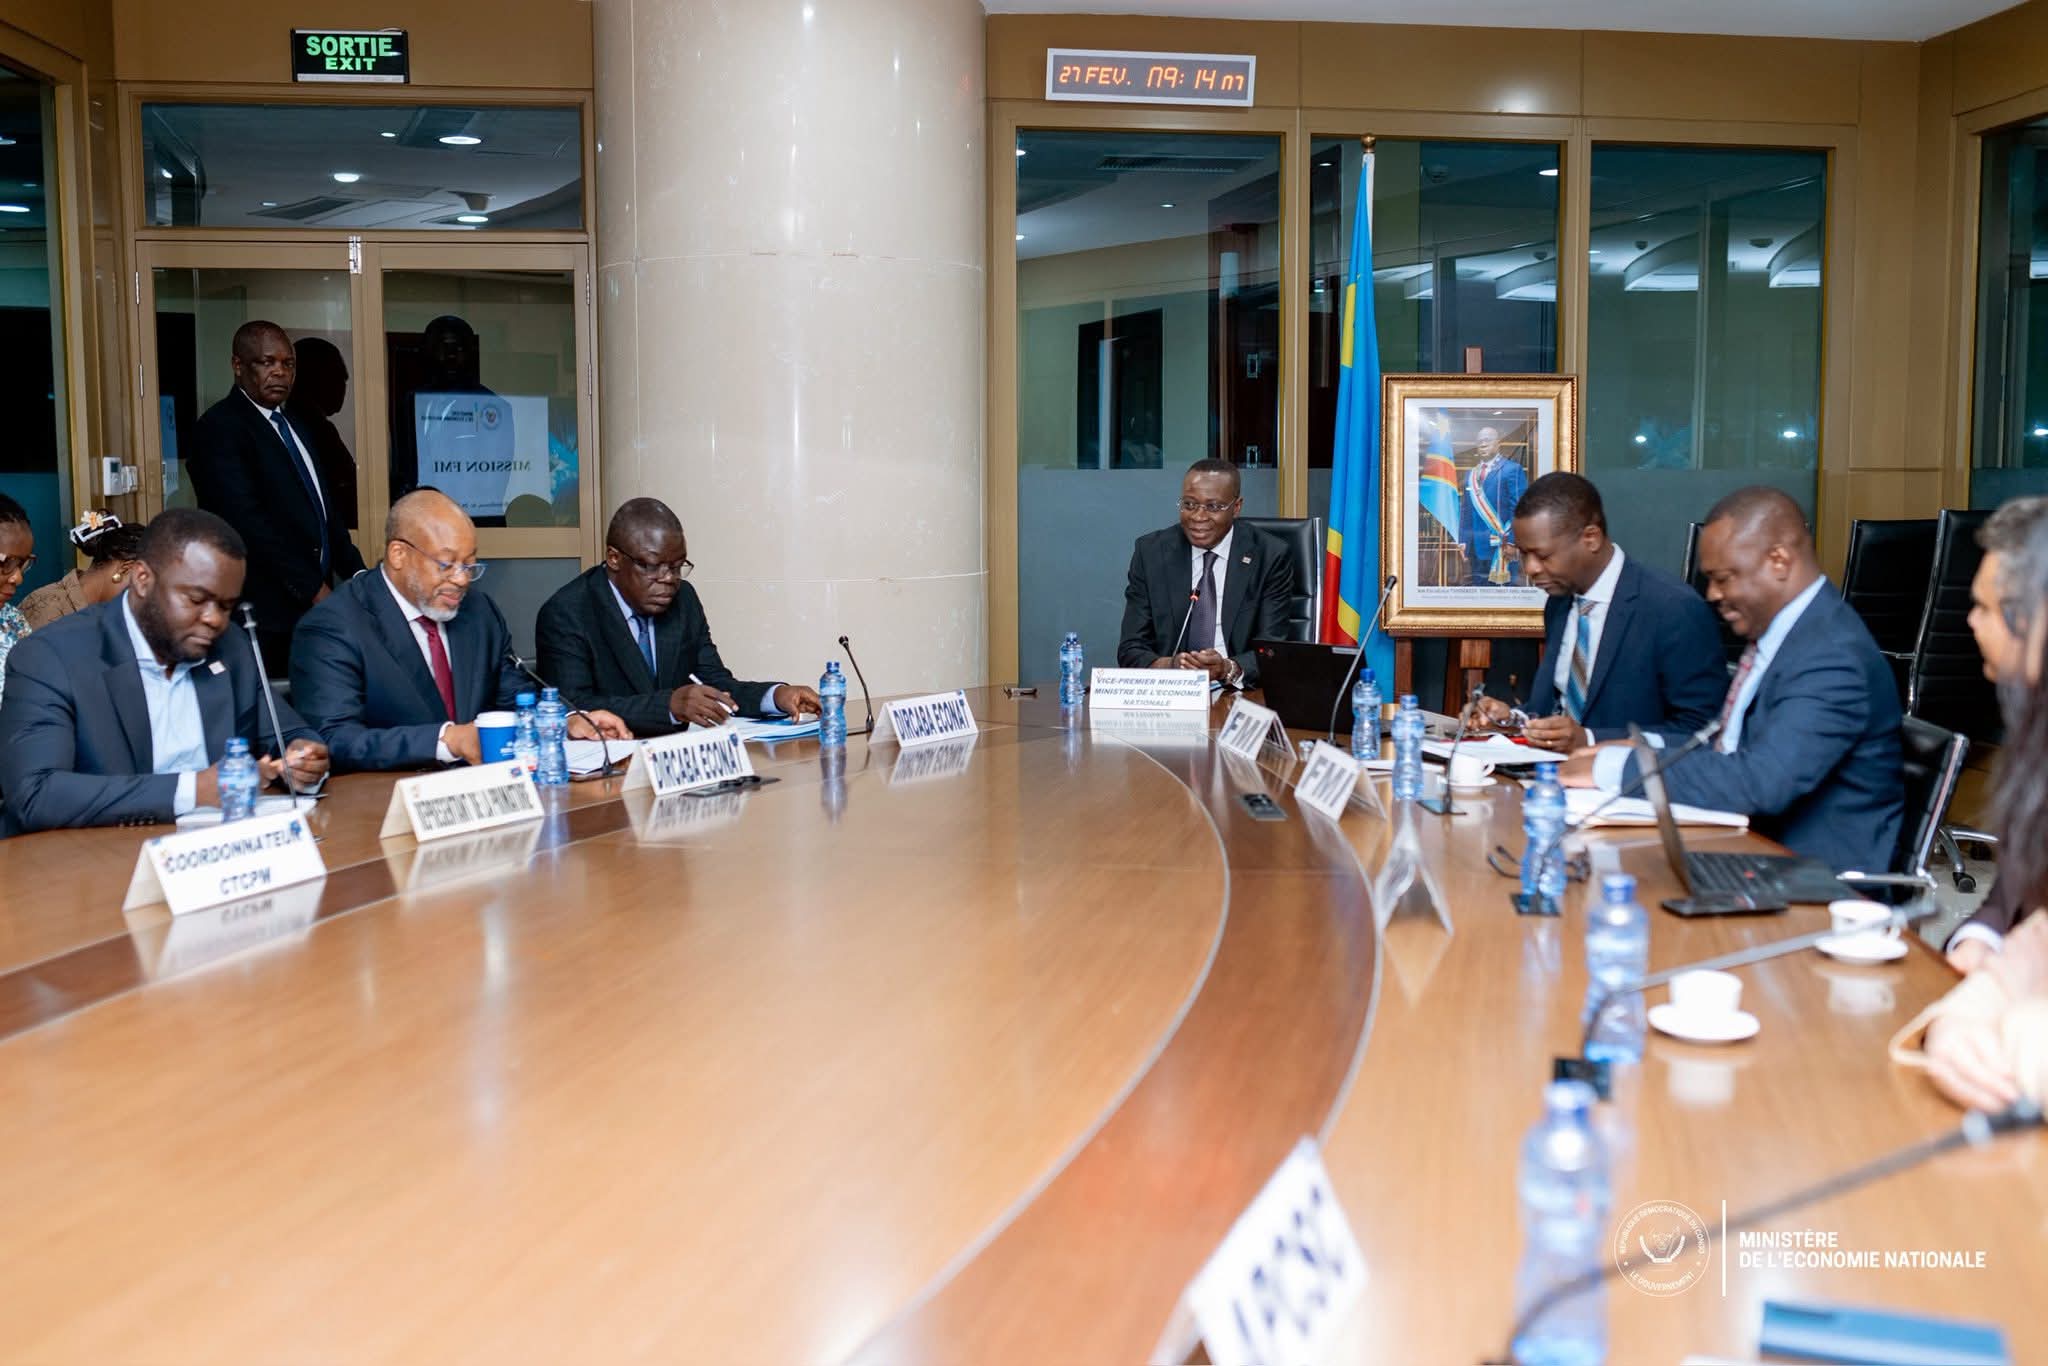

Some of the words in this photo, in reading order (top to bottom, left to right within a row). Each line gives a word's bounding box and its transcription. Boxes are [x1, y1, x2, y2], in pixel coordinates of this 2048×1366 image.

[306, 35, 393, 57] SORTIE
[325, 57, 376, 71] EXIT
[1058, 65, 1081, 84] 27
[1096, 677, 1156, 686] VICE-PREMIER
[1094, 687, 1133, 696] MINISTRE
[1136, 688, 1148, 696] DE
[1123, 699, 1171, 707] NATIONALE
[1222, 711, 1269, 754] FMI
[1301, 756, 1355, 808] FMI
